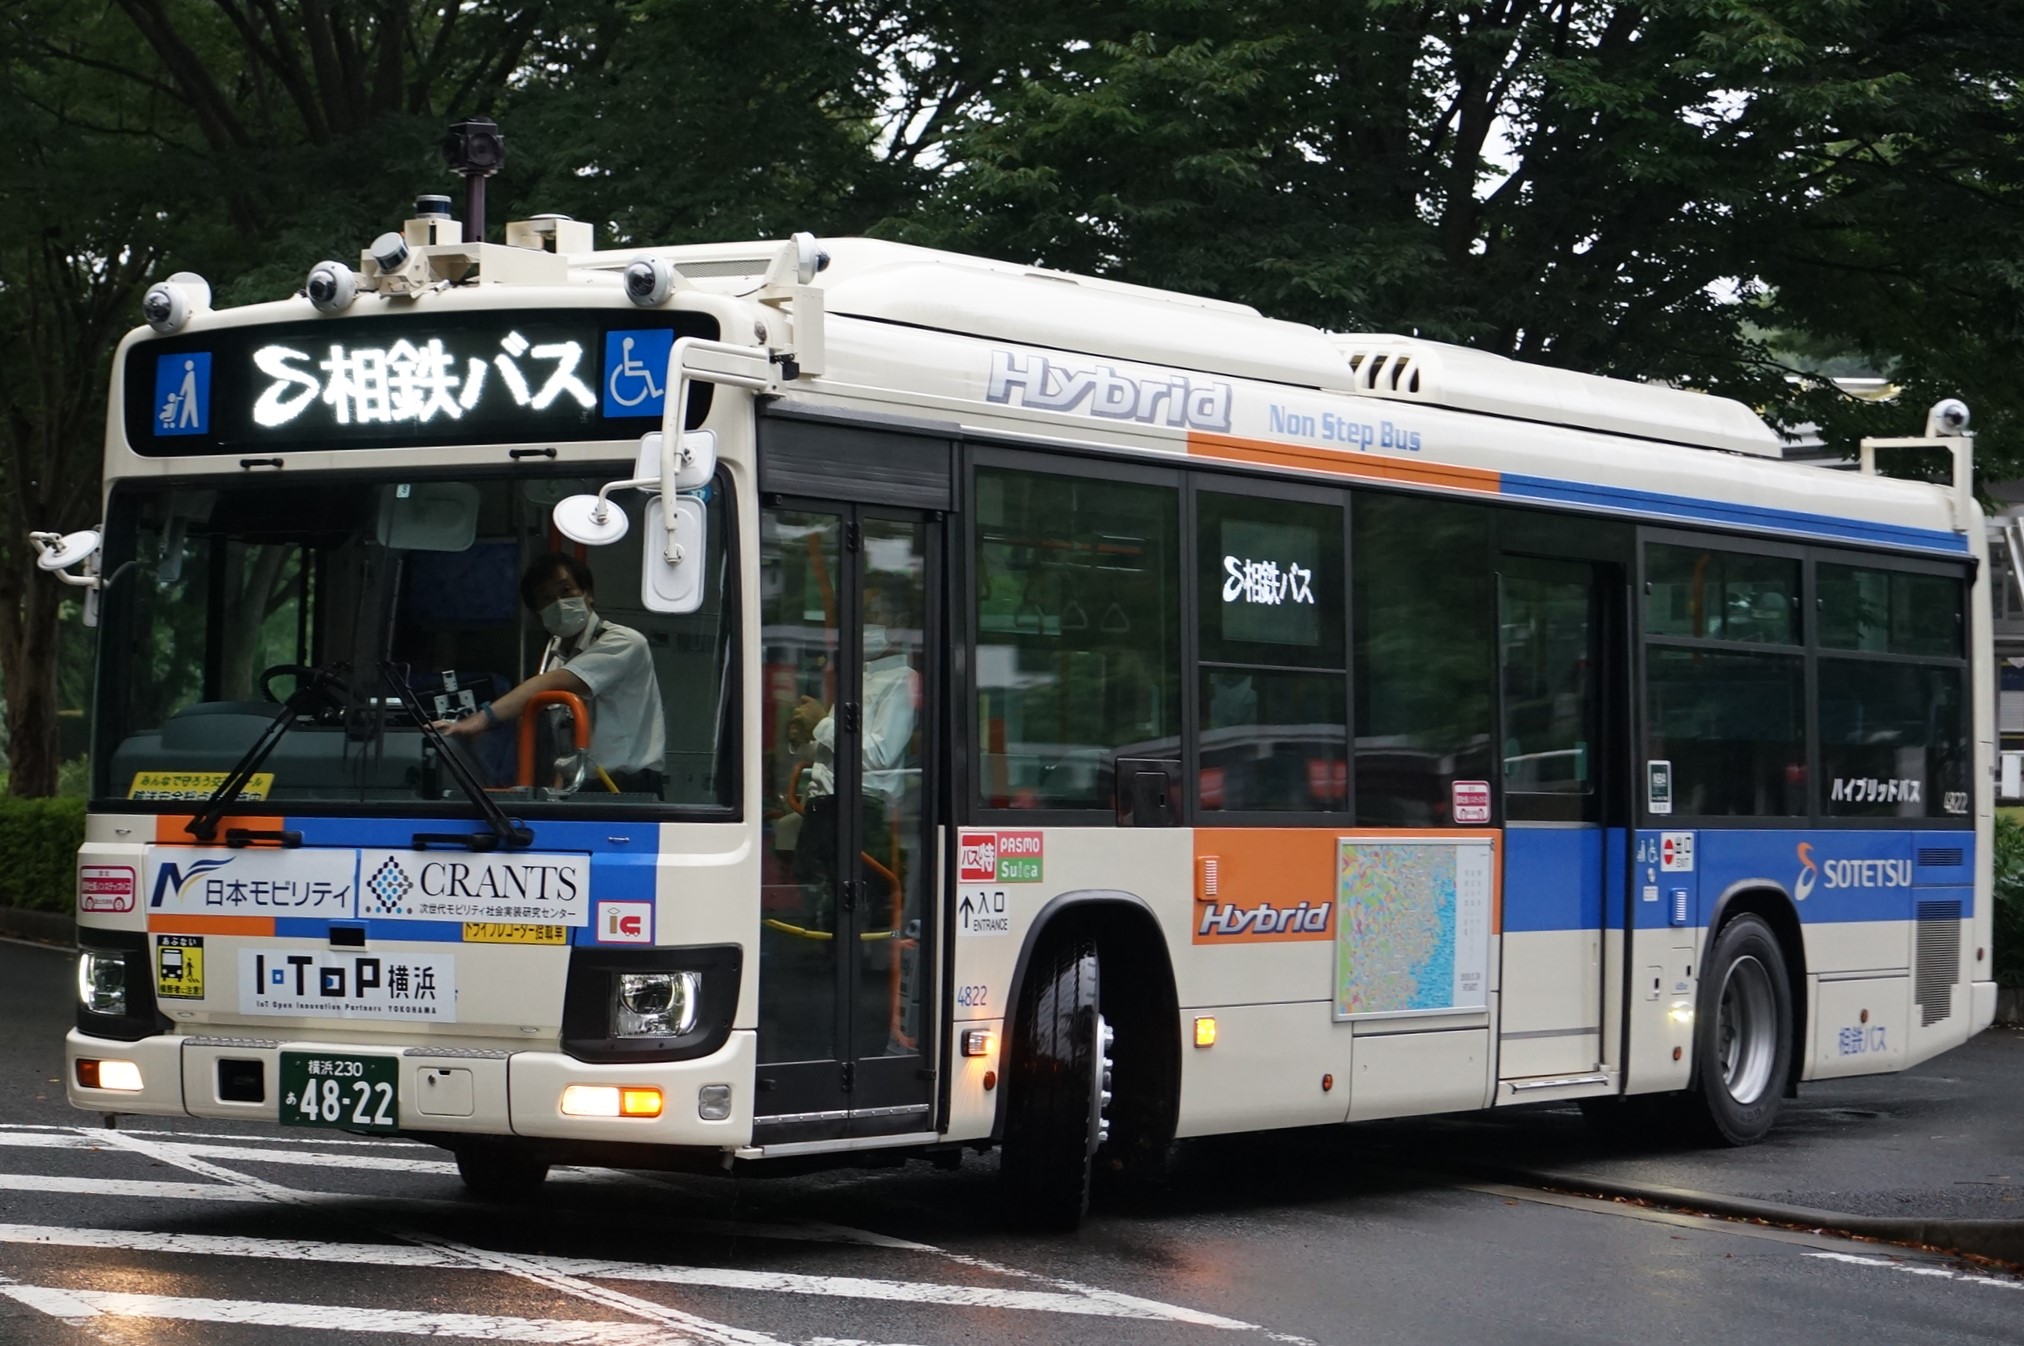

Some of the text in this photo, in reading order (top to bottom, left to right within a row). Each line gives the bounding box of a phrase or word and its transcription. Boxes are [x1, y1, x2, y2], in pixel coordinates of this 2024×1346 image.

[320, 330, 597, 423] 相鉄バス
[987, 350, 1232, 433] Hybrid
[1269, 404, 1422, 453] Non Step Bus
[1243, 558, 1315, 605] 相鉄バス
[1831, 778, 1921, 802] ハイブリッドバス
[1000, 837, 1040, 853] PASMO
[420, 861, 578, 901] CRANTS
[1001, 860, 1039, 878] Suica
[1823, 859, 1912, 888] SOTETSU
[205, 879, 351, 909] 日本モビリティ
[978, 892, 1005, 915] 入口
[973, 918, 1008, 932] ENTRANCE
[1199, 901, 1332, 936] Hybrid
[388, 1005, 437, 1015] YOKOHAMA
[957, 985, 988, 1007] 4822
[285, 1091, 298, 1106] あ
[300, 1078, 394, 1126] 48-22
